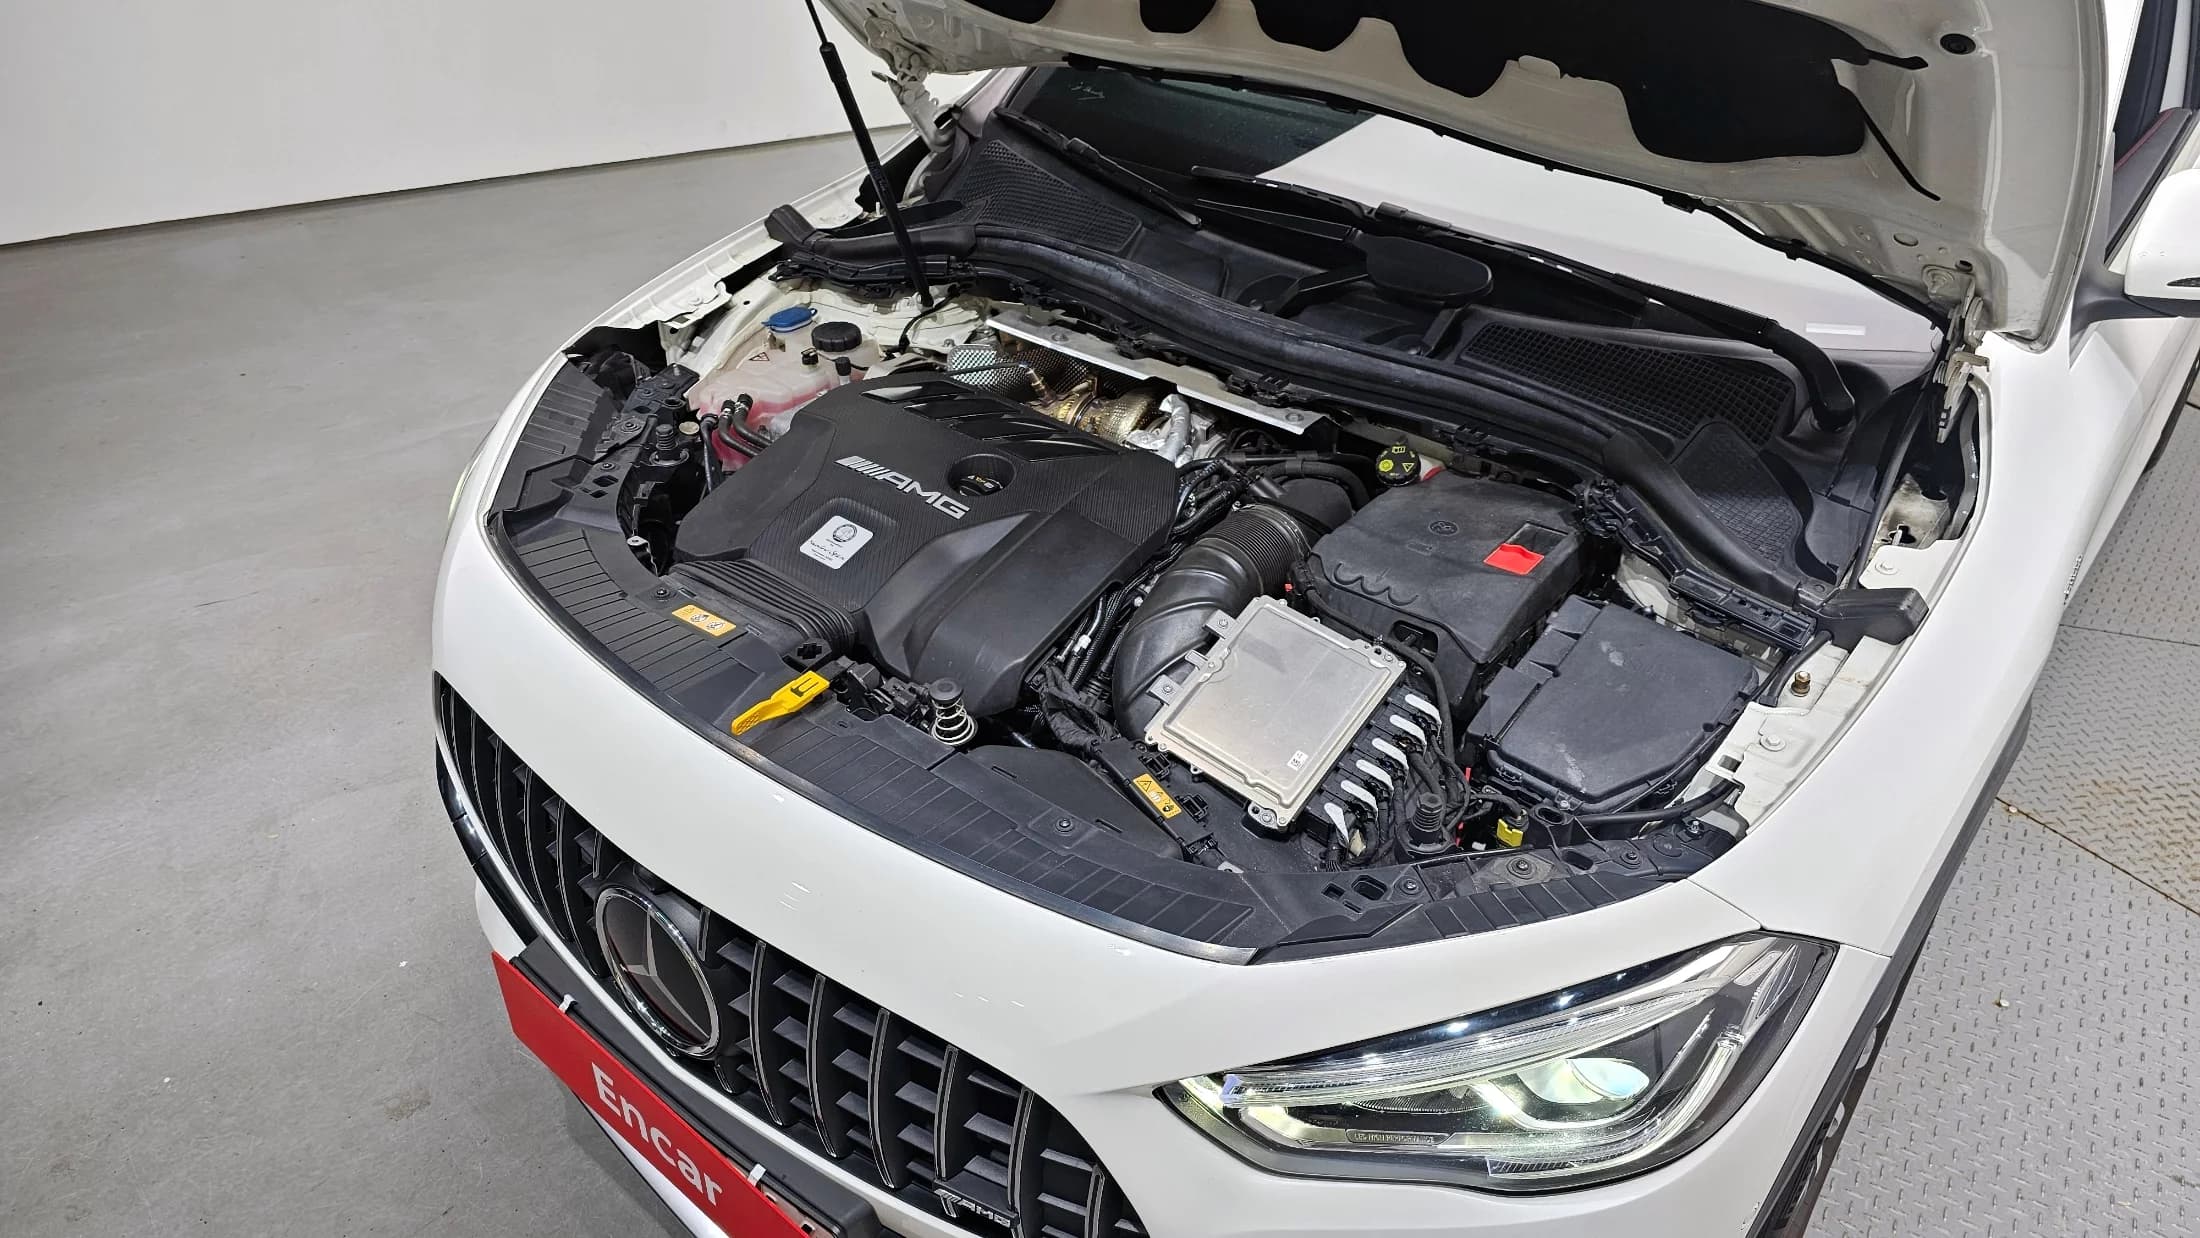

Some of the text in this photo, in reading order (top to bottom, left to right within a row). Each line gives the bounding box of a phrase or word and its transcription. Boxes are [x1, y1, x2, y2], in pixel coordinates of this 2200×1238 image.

[872, 468, 970, 520] AMG
[591, 1061, 723, 1206] Encar
[957, 1198, 1011, 1228] AMG
